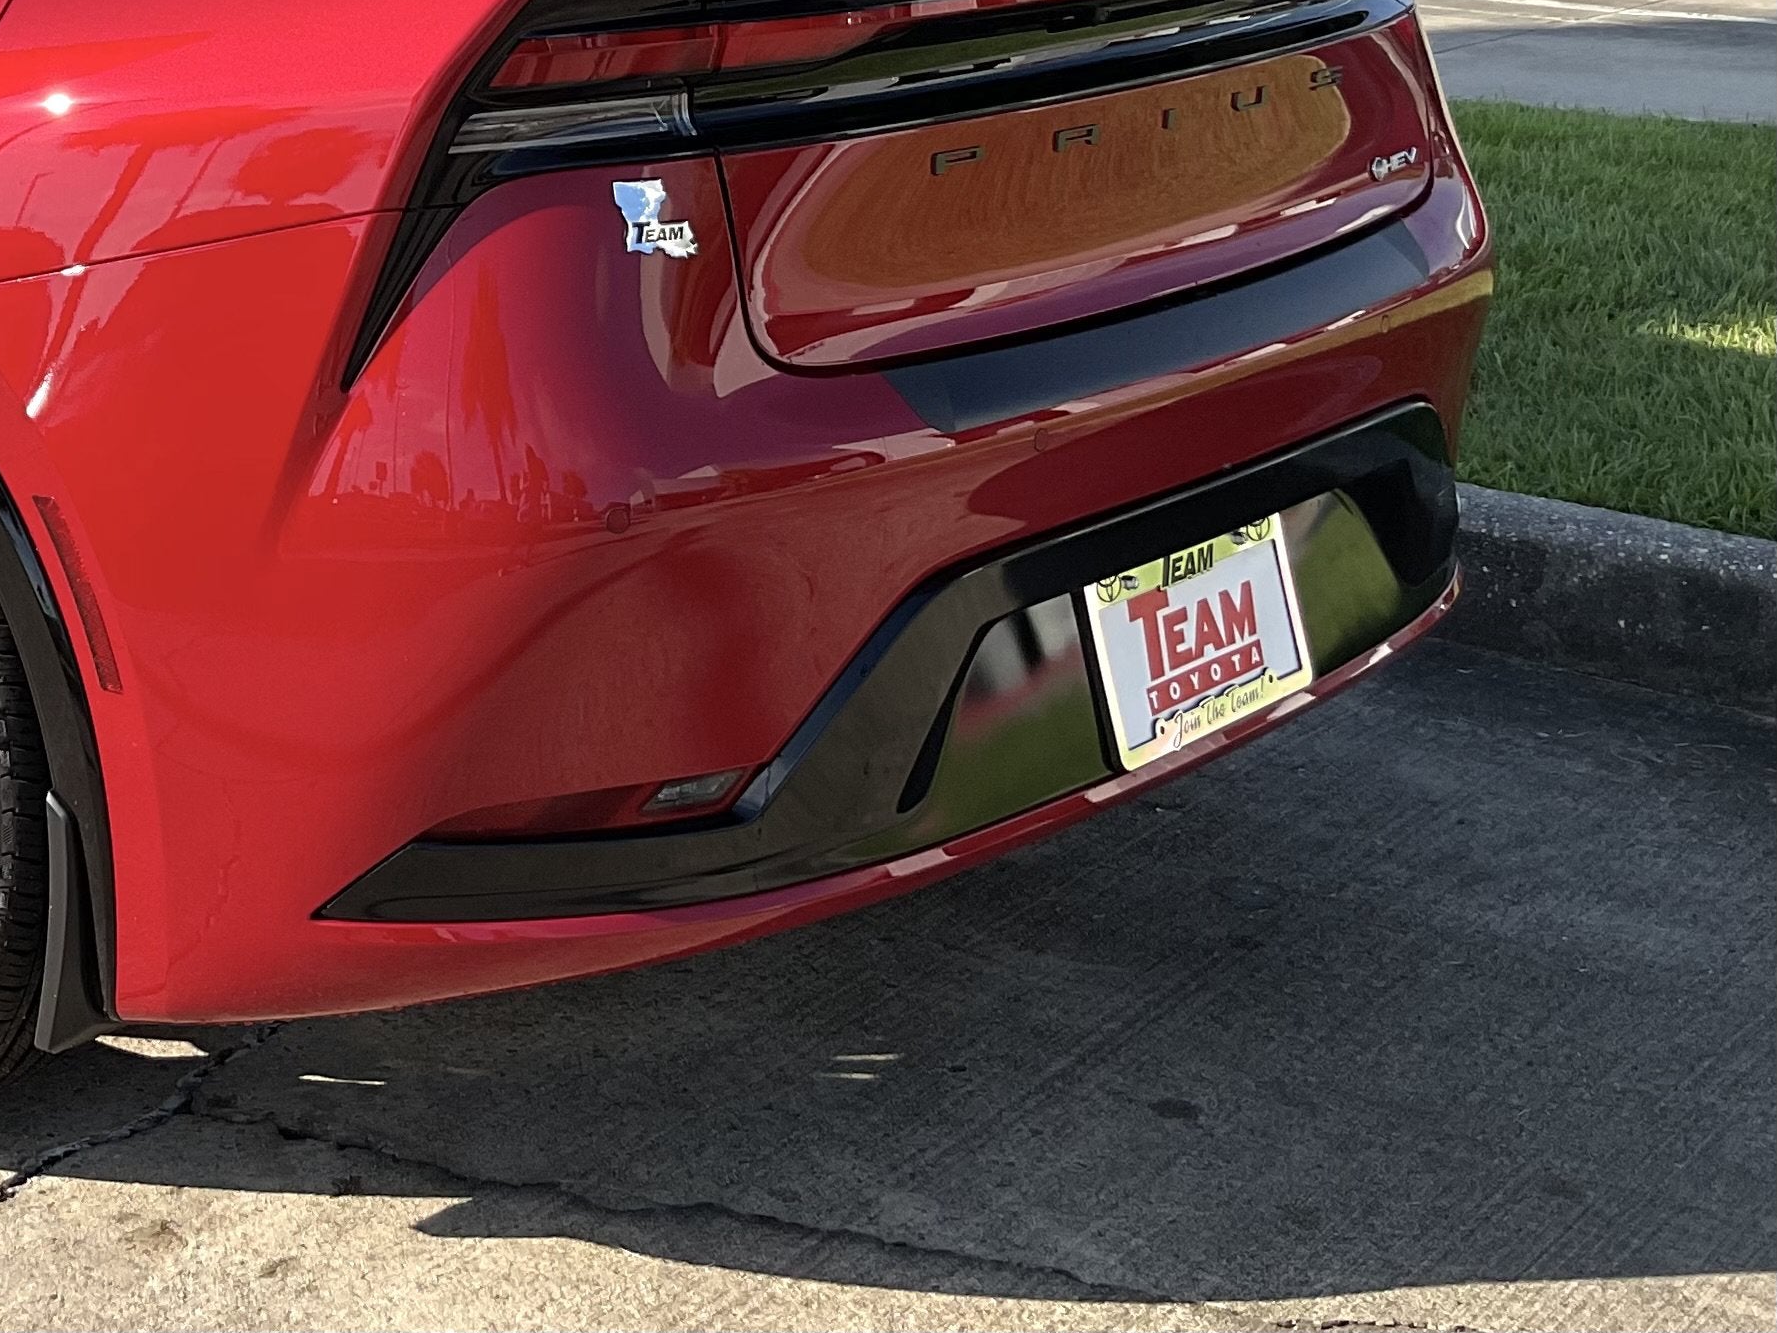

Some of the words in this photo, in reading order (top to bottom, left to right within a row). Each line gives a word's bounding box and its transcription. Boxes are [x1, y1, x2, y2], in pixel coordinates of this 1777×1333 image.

[930, 67, 1343, 175] PRIUS
[1383, 146, 1417, 175] HEV
[632, 221, 684, 244] TEAM
[1127, 579, 1257, 682] TEAM
[1149, 646, 1261, 710] TOYOTA
[1174, 712, 1201, 749] Join
